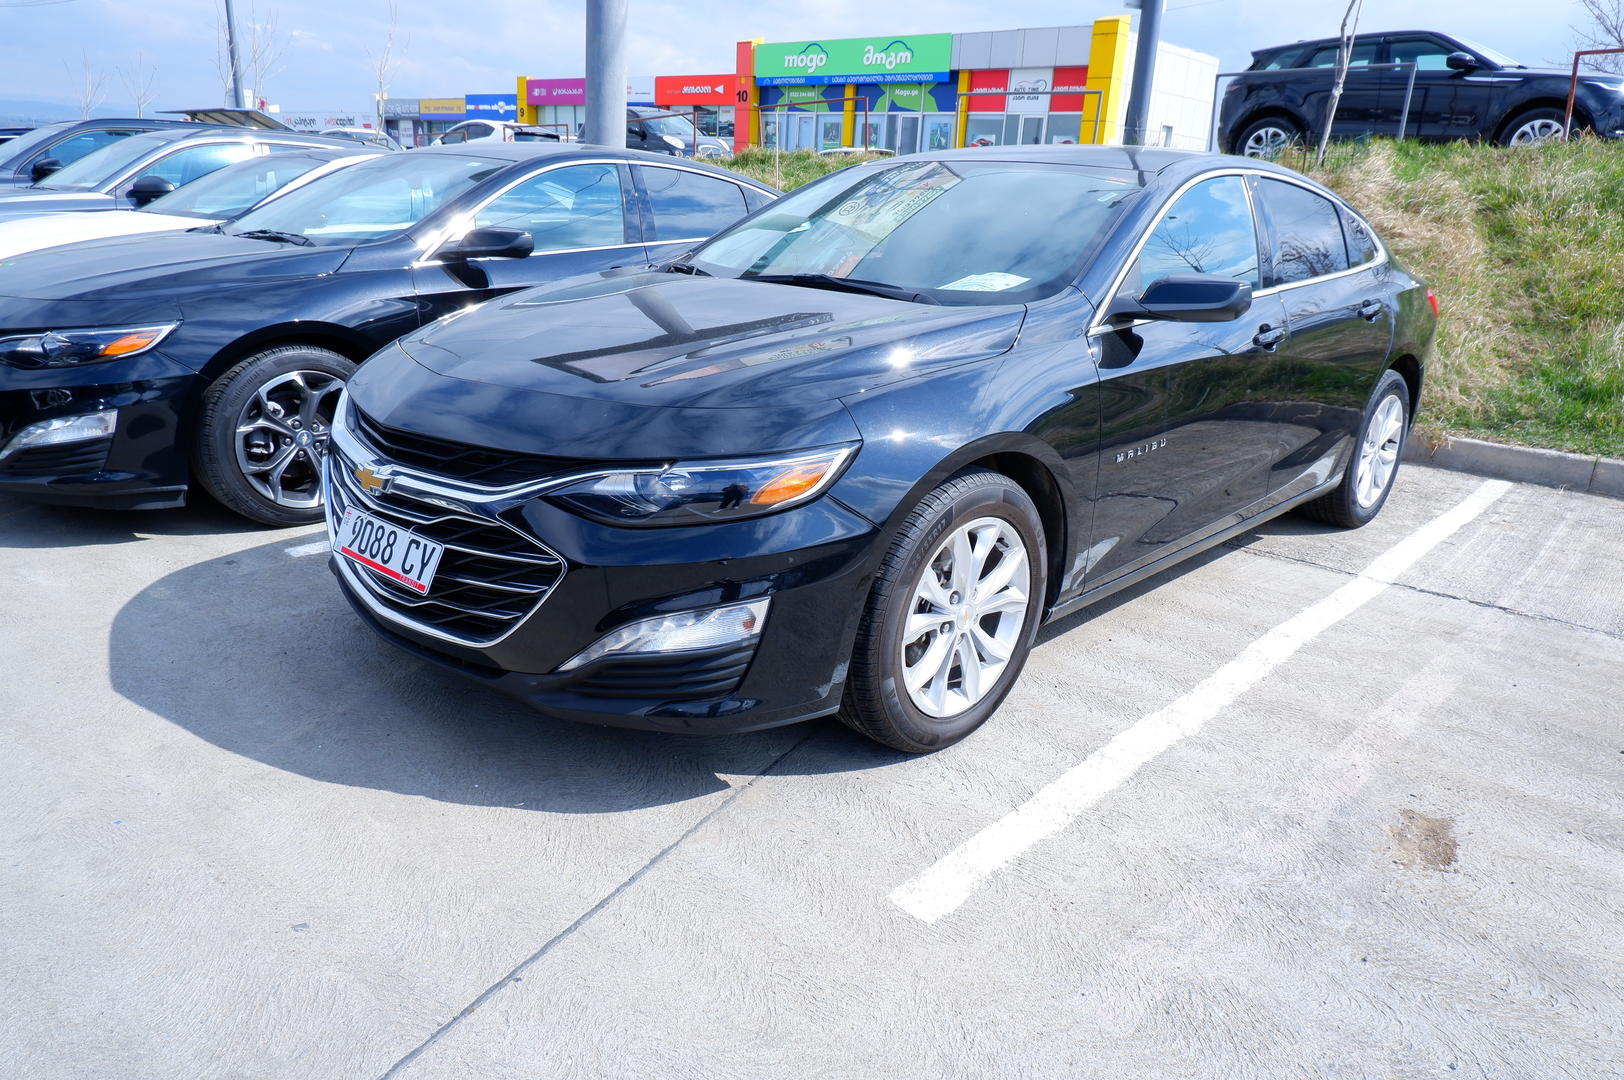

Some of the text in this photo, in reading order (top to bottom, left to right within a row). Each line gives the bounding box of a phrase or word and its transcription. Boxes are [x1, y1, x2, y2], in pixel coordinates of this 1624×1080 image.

[784, 54, 827, 74] mogo
[863, 45, 911, 70] მოგო
[736, 90, 748, 102] 10
[894, 88, 919, 96] Mogo.ge
[519, 107, 525, 117] 9
[1116, 438, 1167, 463] MALIBU
[348, 515, 437, 581] 9088 CY
